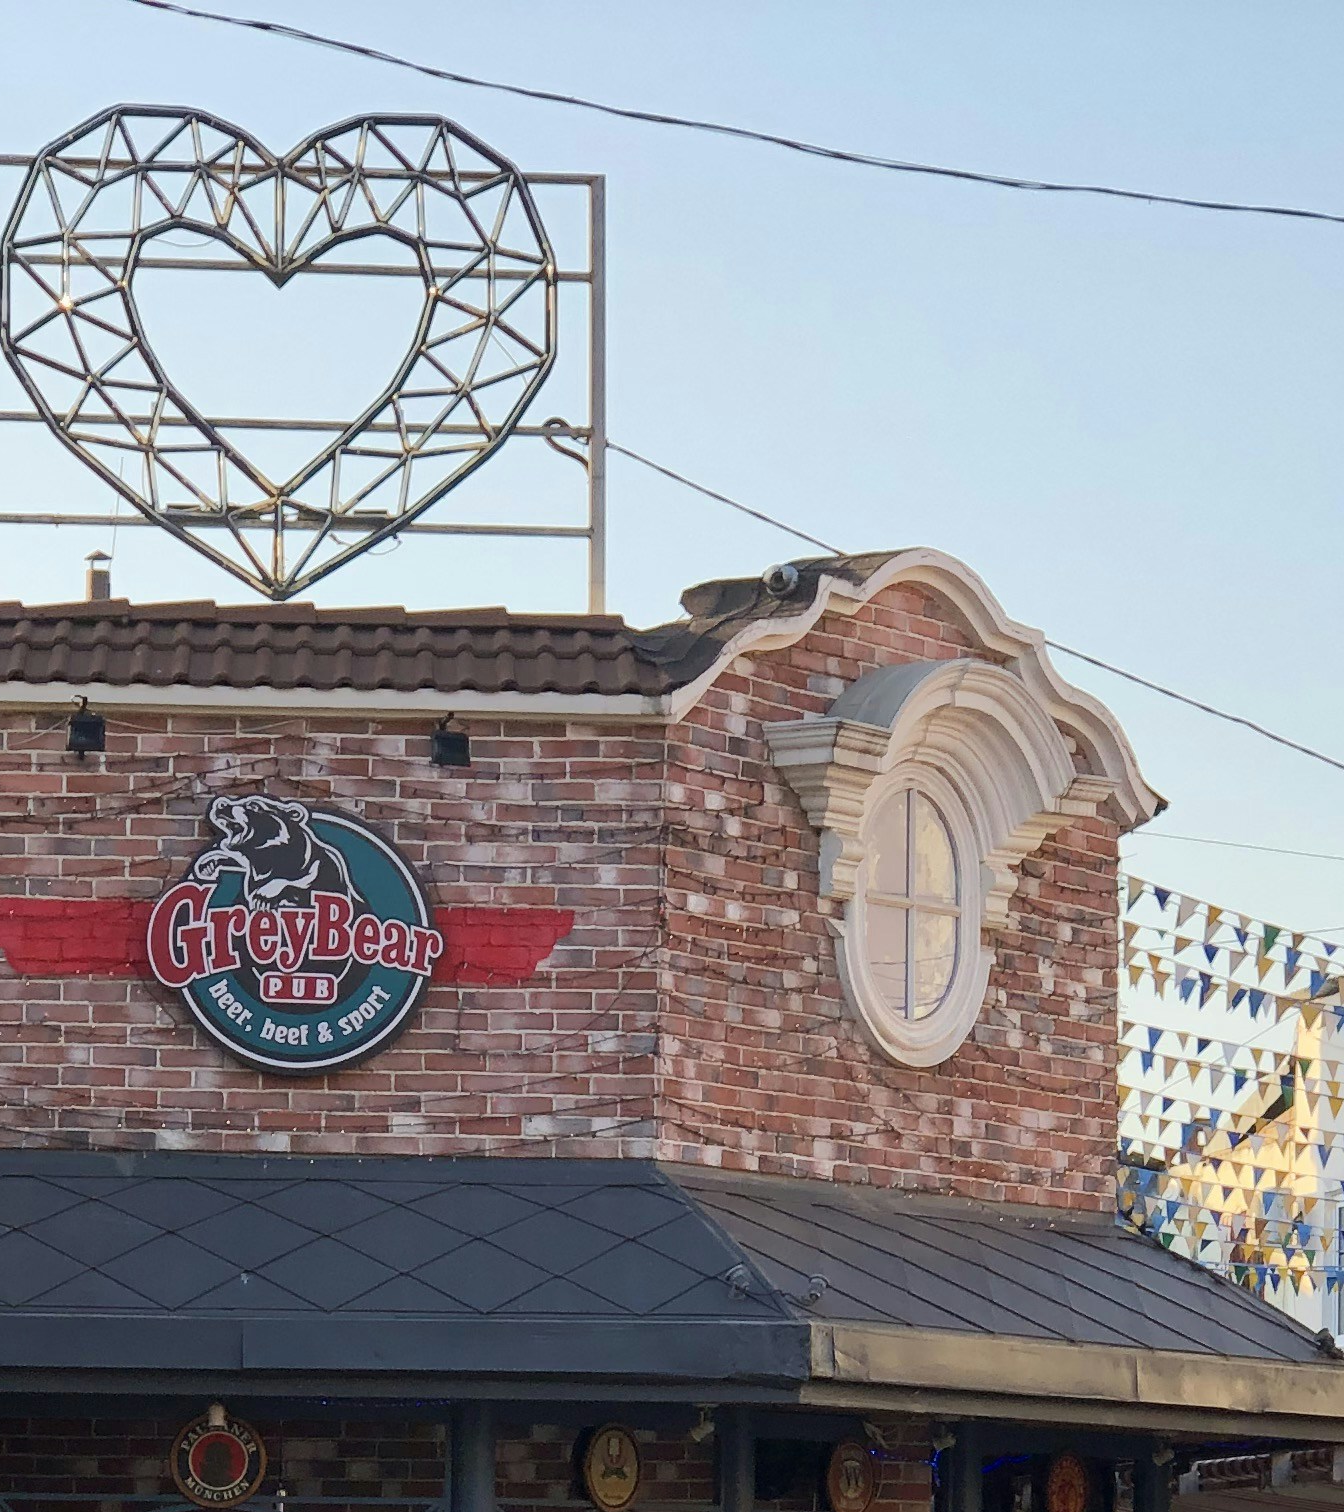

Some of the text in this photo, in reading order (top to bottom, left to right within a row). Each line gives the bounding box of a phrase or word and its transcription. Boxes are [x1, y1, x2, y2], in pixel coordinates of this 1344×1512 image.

[147, 881, 443, 988] GreyBear
[208, 978, 392, 1046] beer, beef & sport
[268, 978, 331, 998] PUB
[180, 1420, 257, 1455] PAUANER
